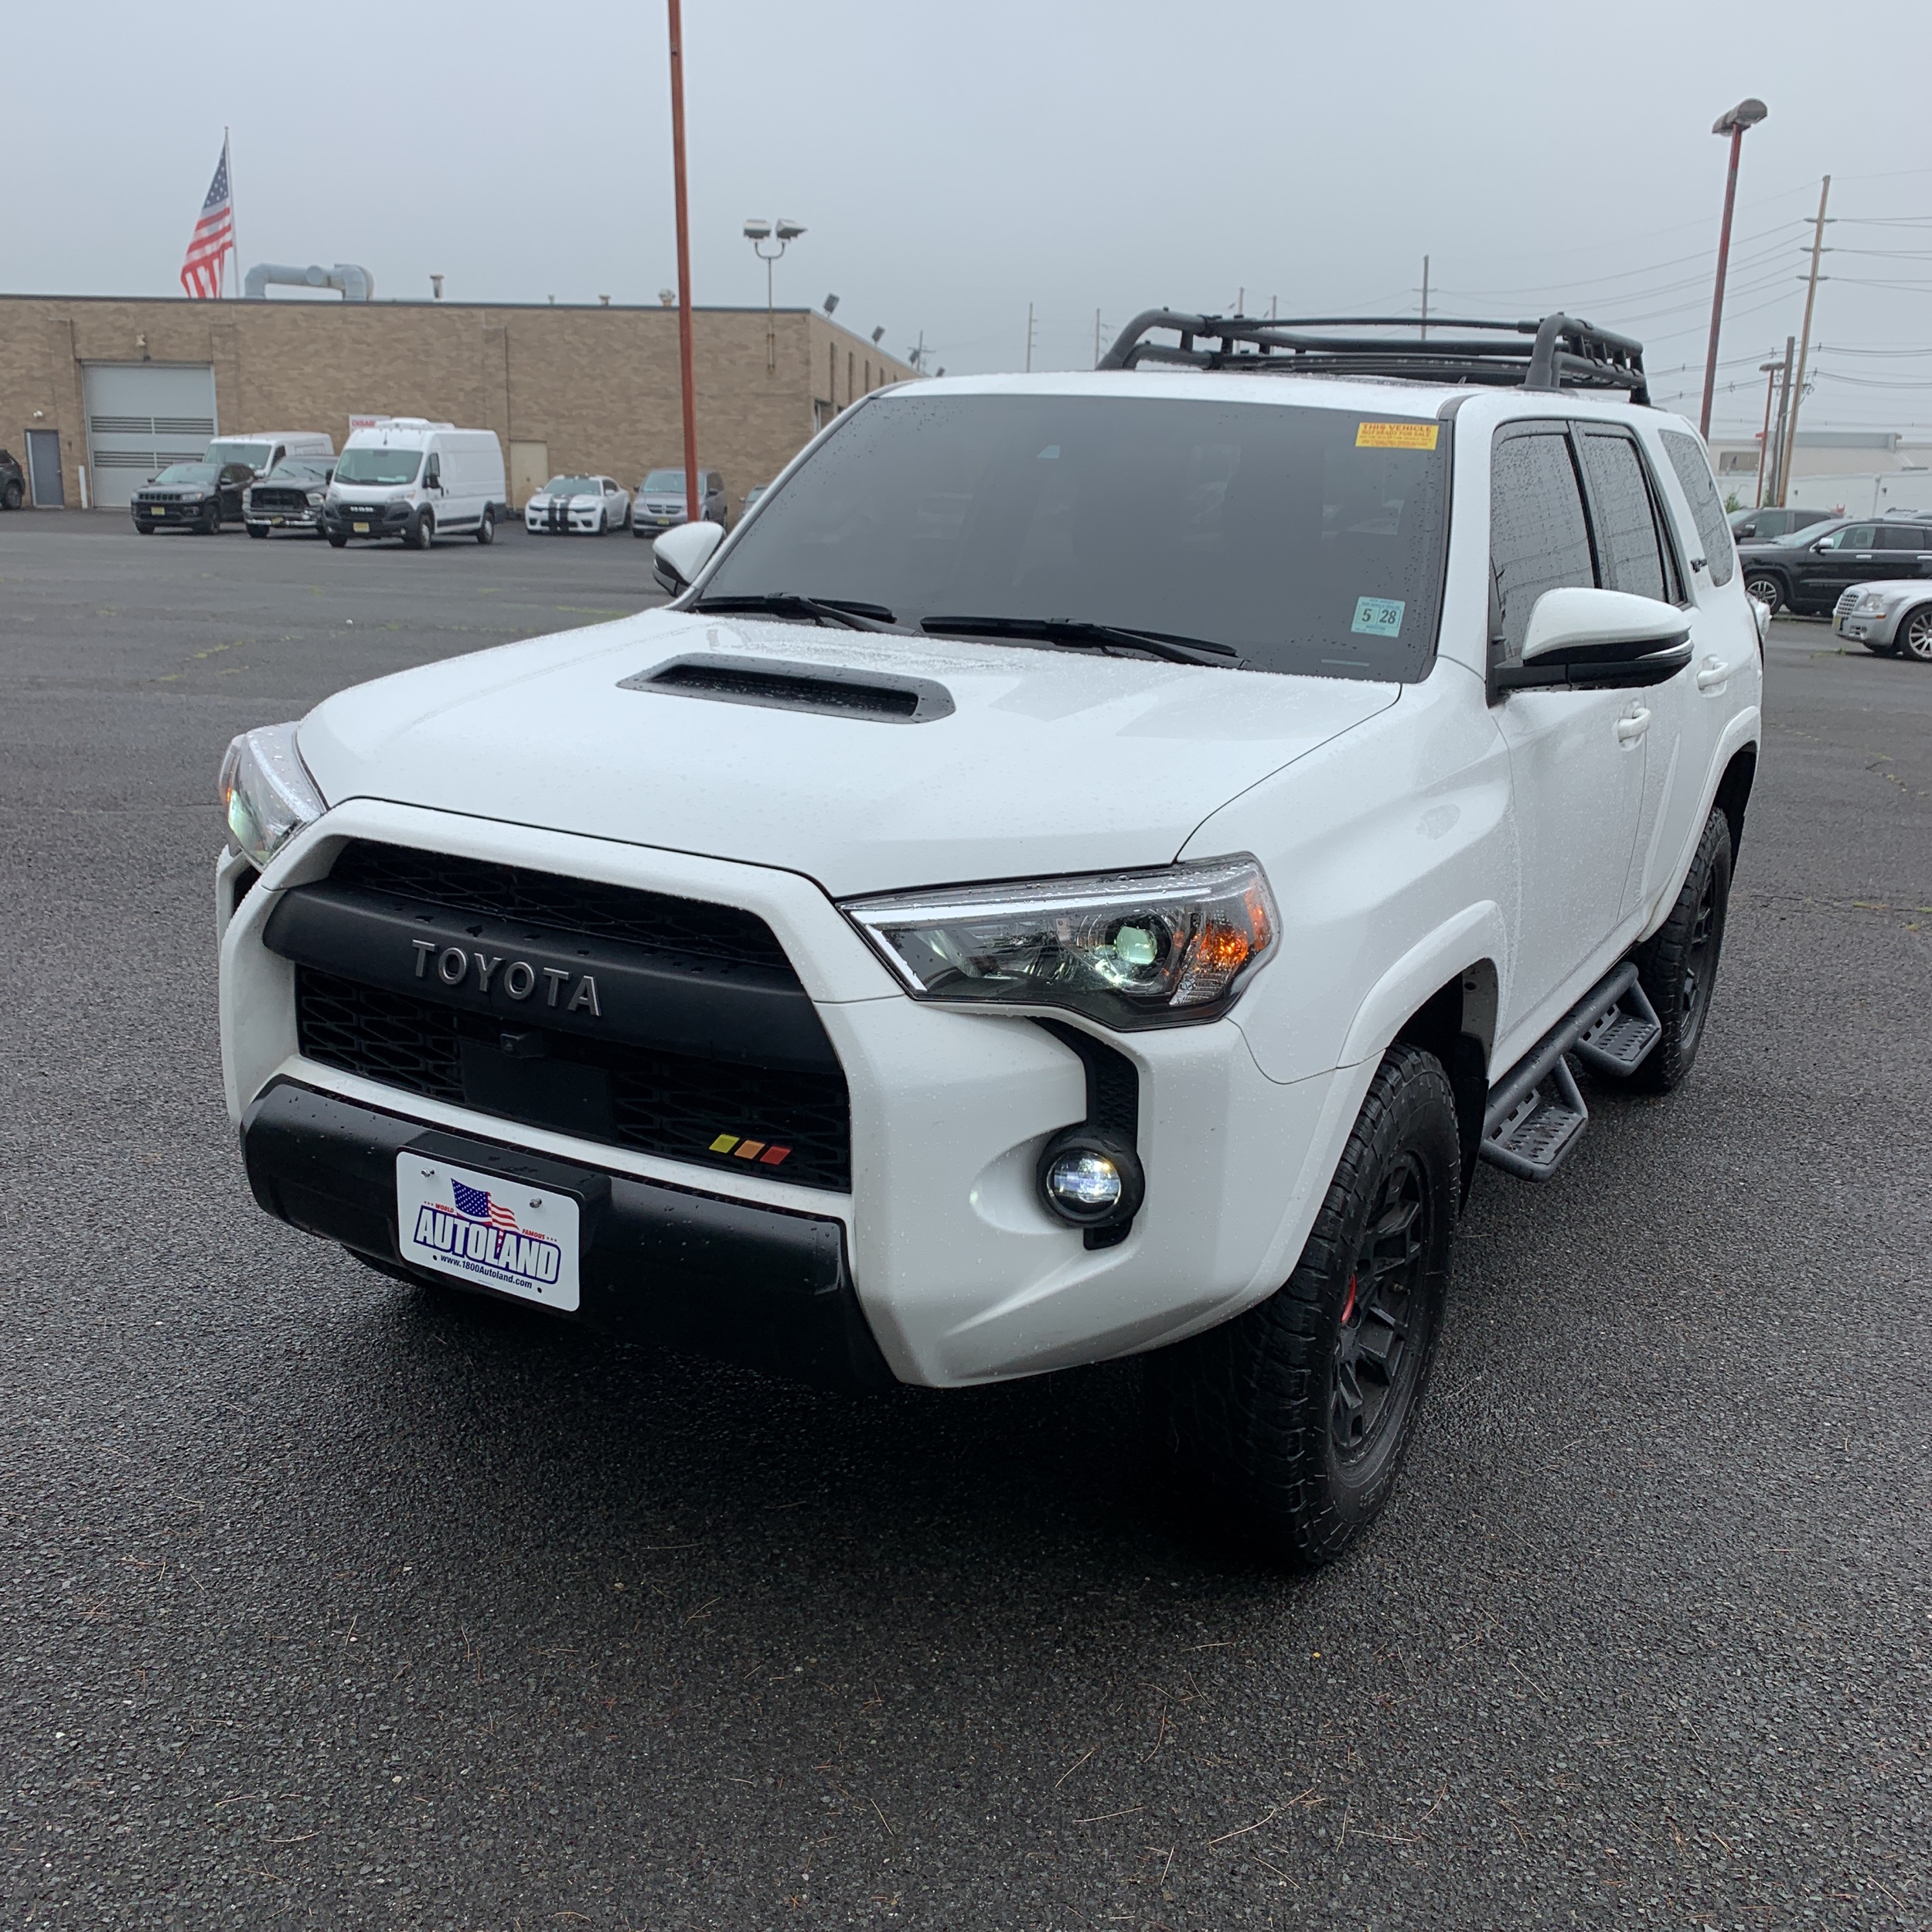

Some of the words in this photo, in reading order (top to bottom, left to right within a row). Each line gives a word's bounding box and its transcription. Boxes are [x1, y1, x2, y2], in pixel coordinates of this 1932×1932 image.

[1361, 608, 1372, 622] 5
[1379, 609, 1397, 625] 28
[411, 939, 602, 1017] TOYOTA
[435, 1202, 455, 1213] WORLD
[522, 1228, 546, 1240] FAMOUS
[414, 1205, 561, 1285] AUTOLAND
[440, 1253, 533, 1290] www.1800Autoland.com
